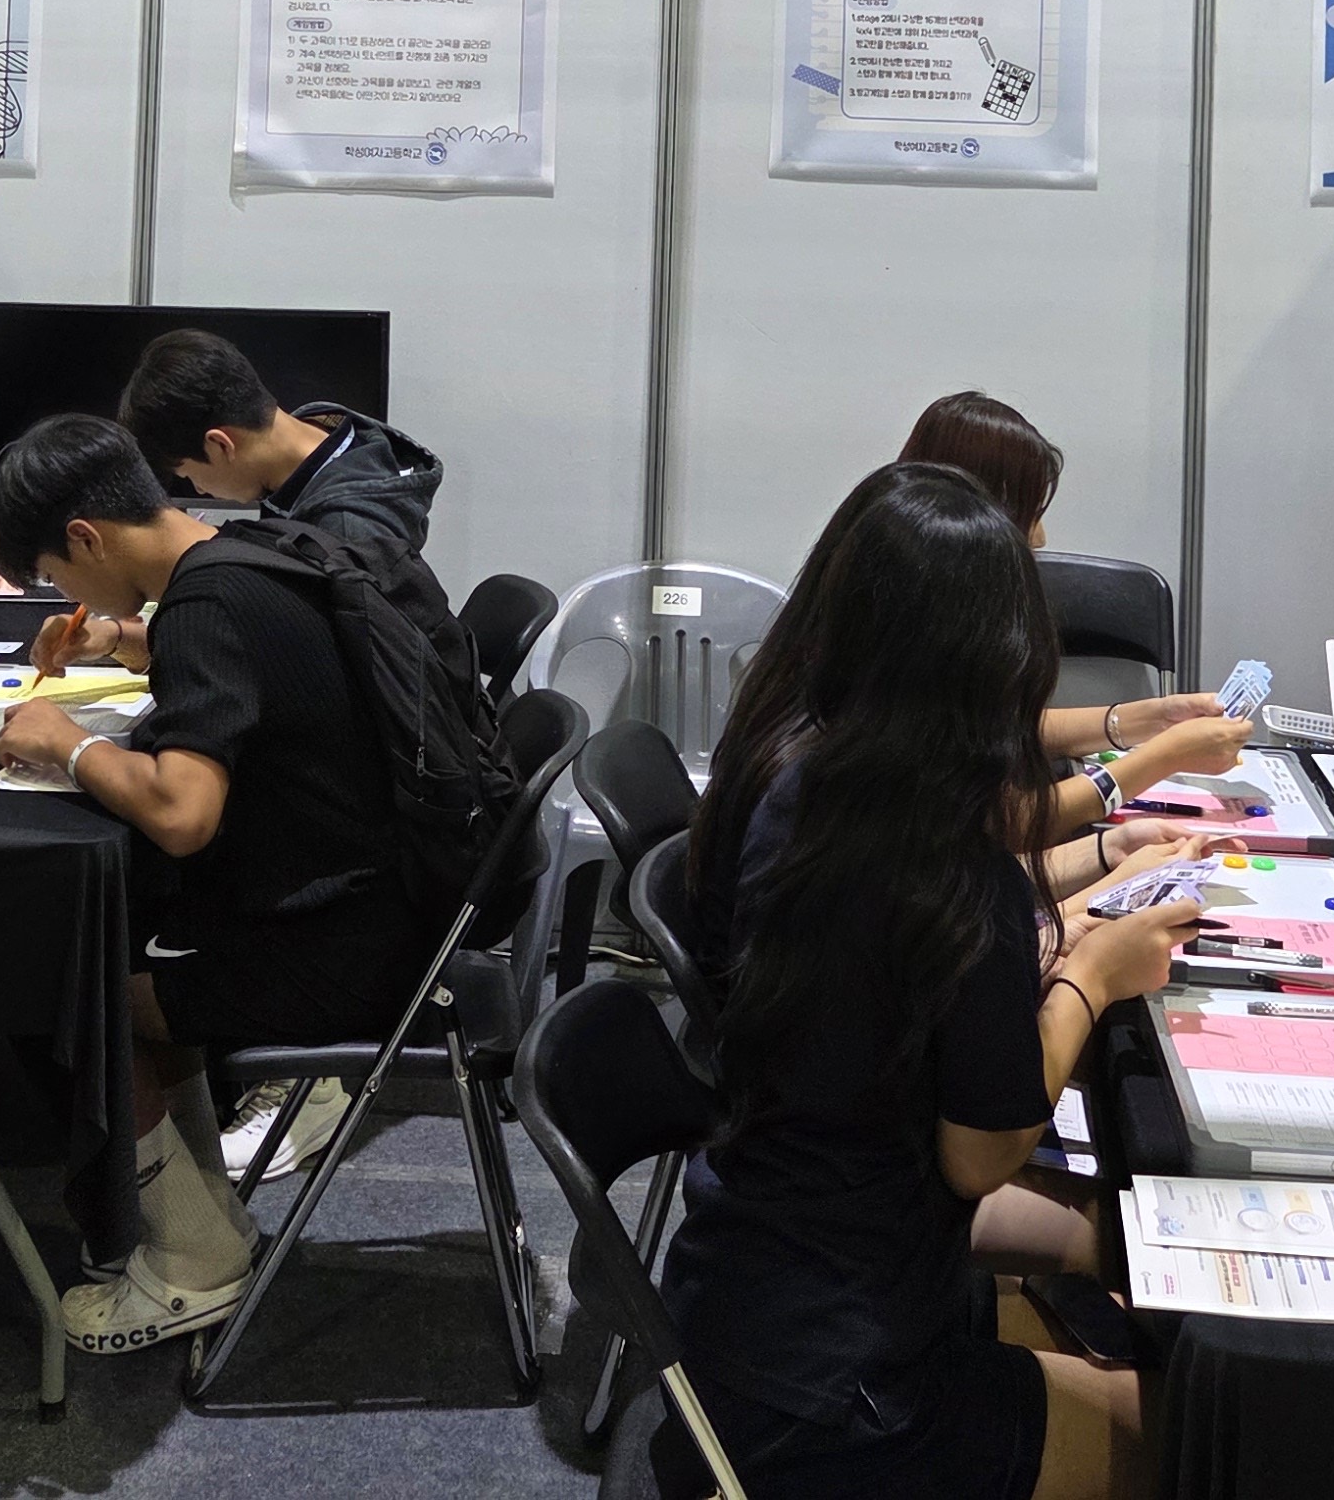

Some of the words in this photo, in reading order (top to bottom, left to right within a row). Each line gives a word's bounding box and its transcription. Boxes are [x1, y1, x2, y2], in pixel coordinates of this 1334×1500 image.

[344, 146, 423, 160] 학성여자고등학교
[663, 592, 688, 606] 226
[82, 1324, 161, 1351] crocs
